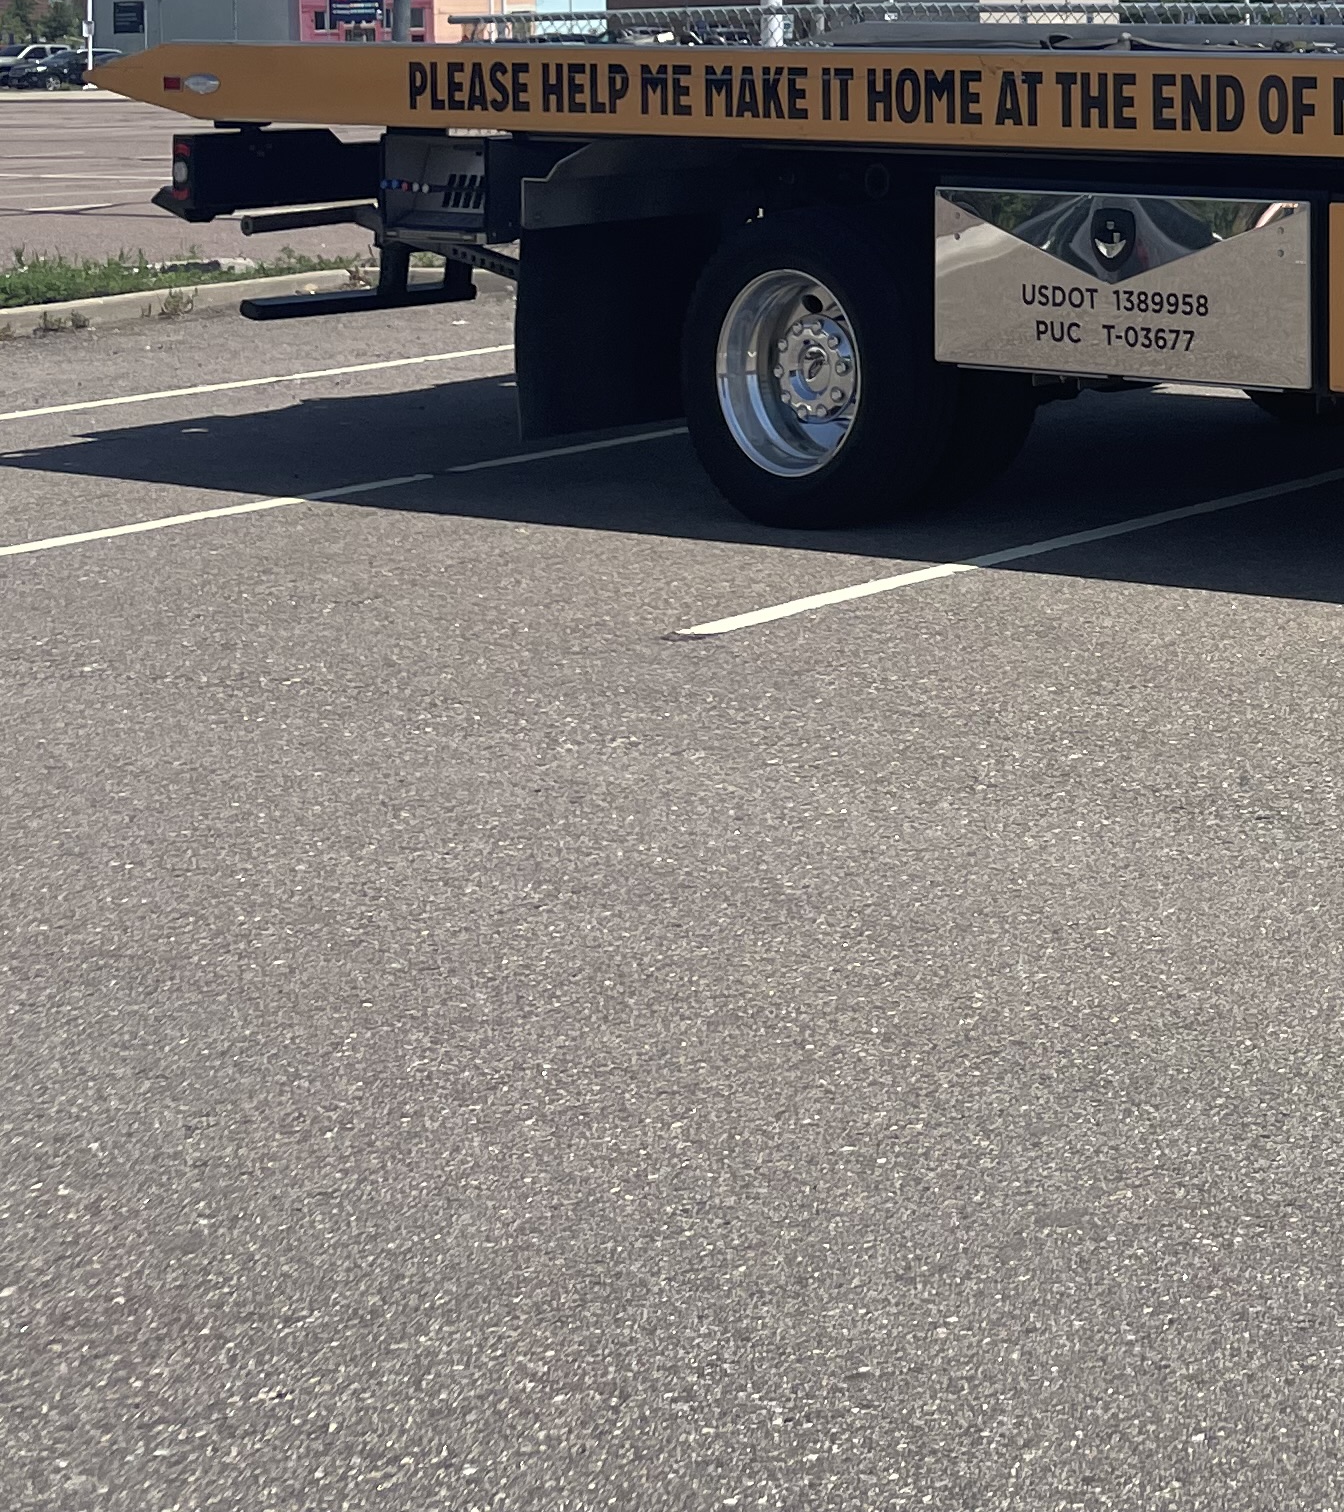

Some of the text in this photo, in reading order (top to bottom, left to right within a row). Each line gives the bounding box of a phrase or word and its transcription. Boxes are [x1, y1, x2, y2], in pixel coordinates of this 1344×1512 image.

[408, 61, 531, 113] PLEASE
[541, 63, 630, 115] HELP
[640, 63, 693, 116] ME
[704, 65, 809, 120] MAKE
[821, 67, 855, 121] IT
[866, 68, 983, 125] HOME
[994, 70, 1043, 127] AT
[1055, 71, 1137, 129] THE
[1151, 73, 1245, 132] END
[1258, 74, 1318, 135] OF
[1022, 283, 1209, 317] USDOT 1389958
[1035, 319, 1196, 352] PUC T-03677
